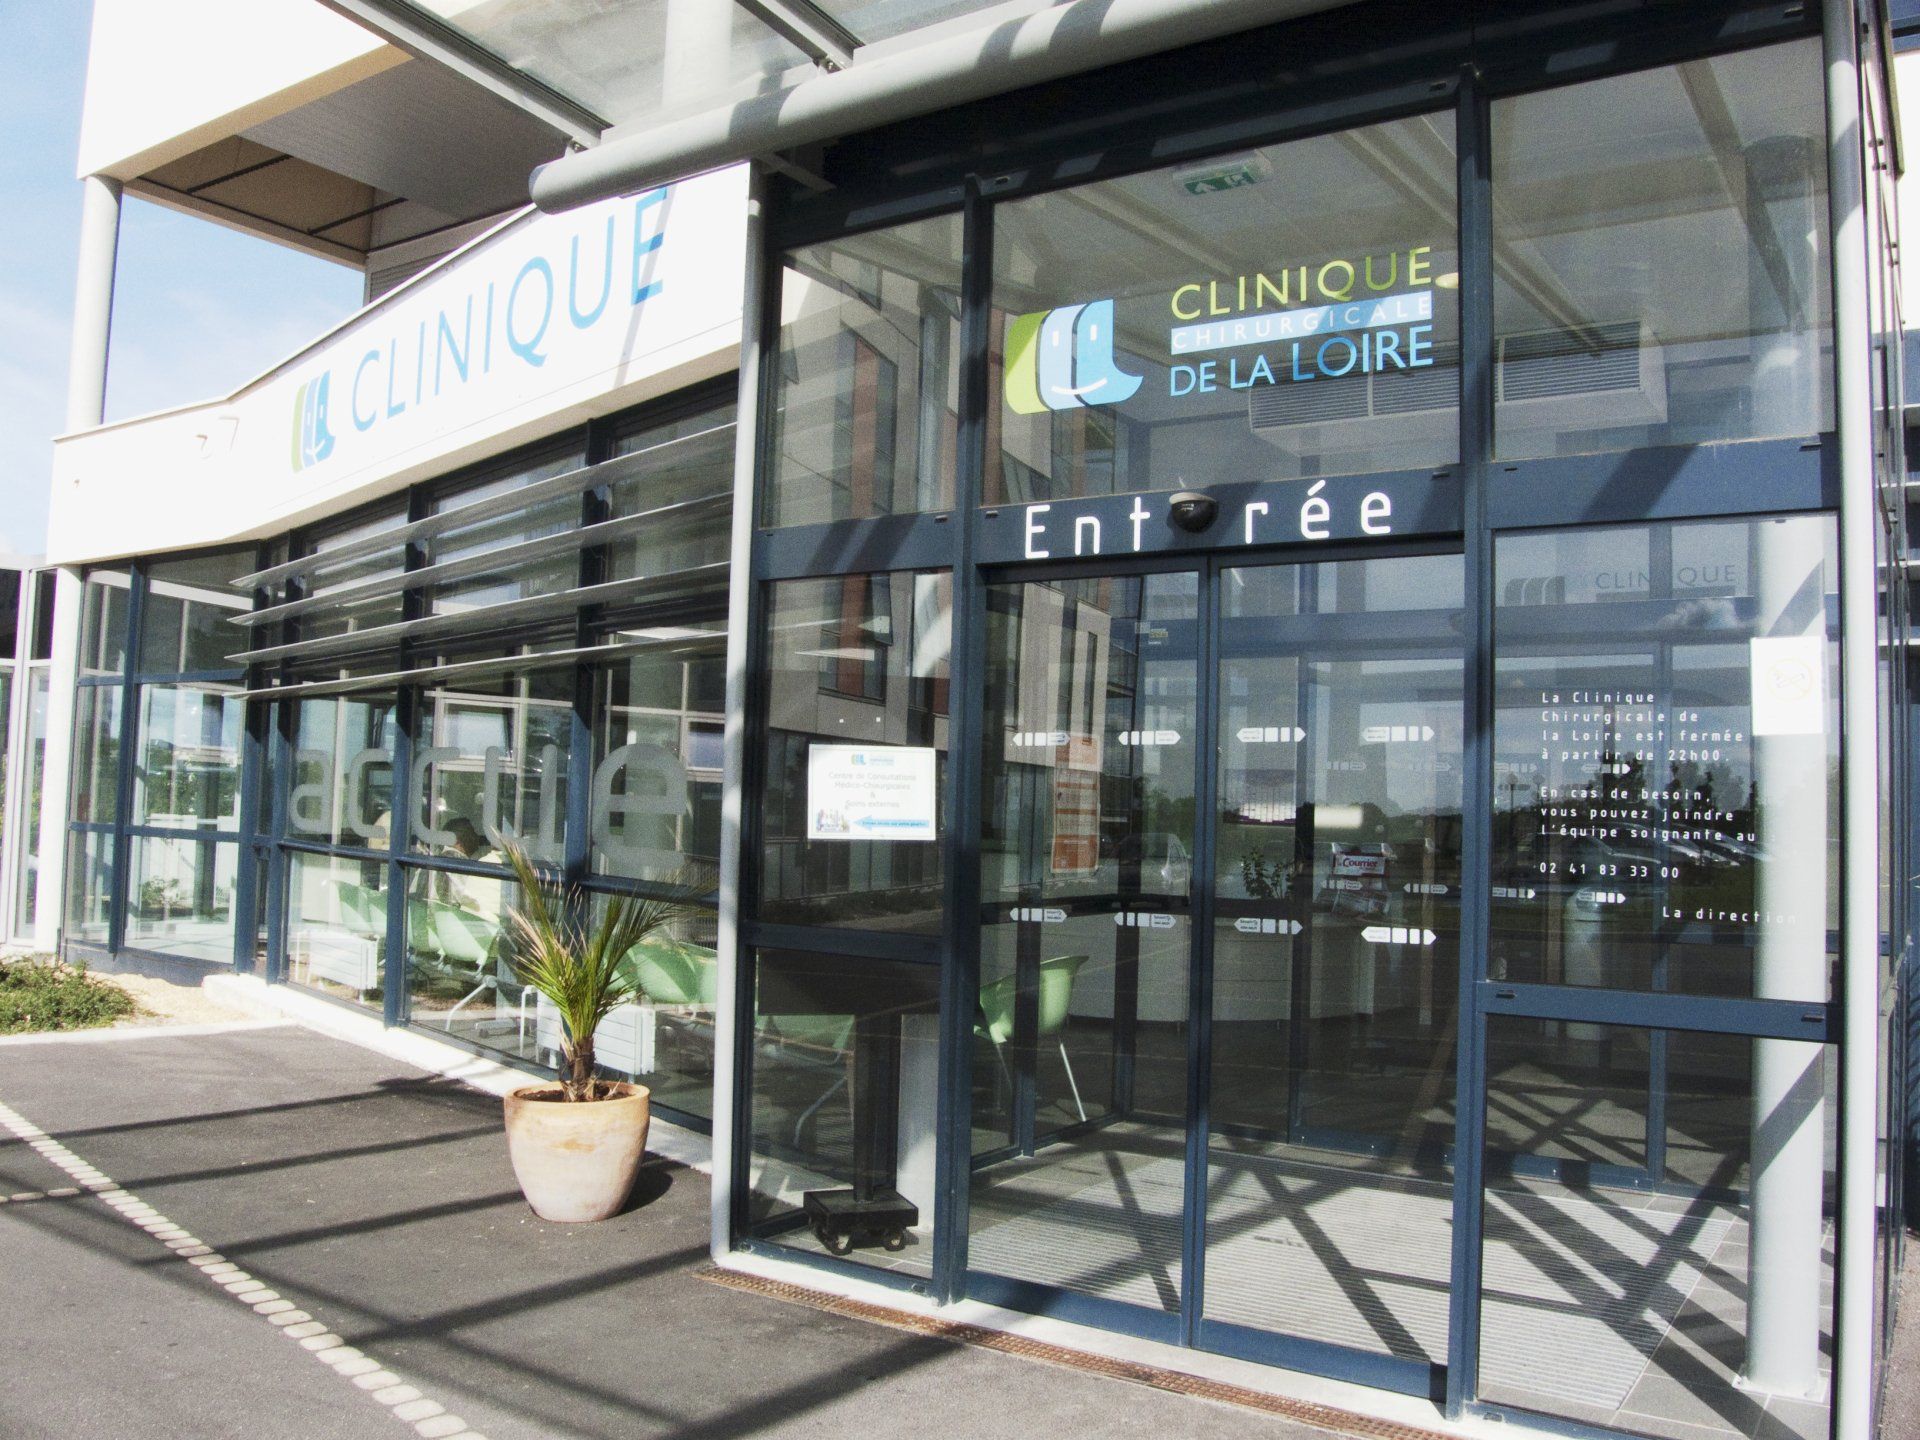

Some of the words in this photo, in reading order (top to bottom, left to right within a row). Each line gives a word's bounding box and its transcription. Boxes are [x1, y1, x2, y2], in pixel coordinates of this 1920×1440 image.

[1171, 246, 1431, 320] CLINIQUE
[352, 187, 668, 433] CLINIQUE
[1172, 296, 1431, 347] CHIRURGICALE
[1170, 362, 1216, 397] DE
[1229, 355, 1275, 389] LA
[1292, 324, 1434, 382] LOIRE
[1024, 480, 1392, 560] Entrée
[1595, 564, 1737, 588] CLINQUE
[1542, 692, 1559, 704] La
[1572, 691, 1655, 706] Clinique
[1542, 710, 1665, 726] Chirurgicale
[1679, 710, 1699, 722] de
[1542, 730, 1558, 742] la
[1572, 730, 1622, 742] Loire
[1636, 730, 1664, 742] est
[1679, 727, 1743, 742] fermée
[1541, 748, 1549, 761] à
[1562, 750, 1621, 764] partir
[1635, 750, 1654, 762] de
[1668, 749, 1730, 762] 22h00.
[1541, 787, 1558, 799] En
[1571, 789, 1598, 801] cas
[1610, 788, 1629, 801] de
[1641, 788, 1710, 804] besoin,
[1540, 807, 1577, 819] vous
[1590, 809, 1649, 821] pouvez
[1662, 808, 1734, 821] joindre
[1541, 825, 1618, 840] l'équipe
[1630, 828, 1723, 842] soignante
[1736, 832, 1757, 842] au
[1540, 862, 1557, 875] 02
[1569, 863, 1587, 875] 41
[1599, 864, 1617, 877] 83
[1630, 864, 1648, 878] 33
[1661, 866, 1680, 879] 00
[1663, 906, 1681, 919] La
[1696, 907, 1797, 925] direction
